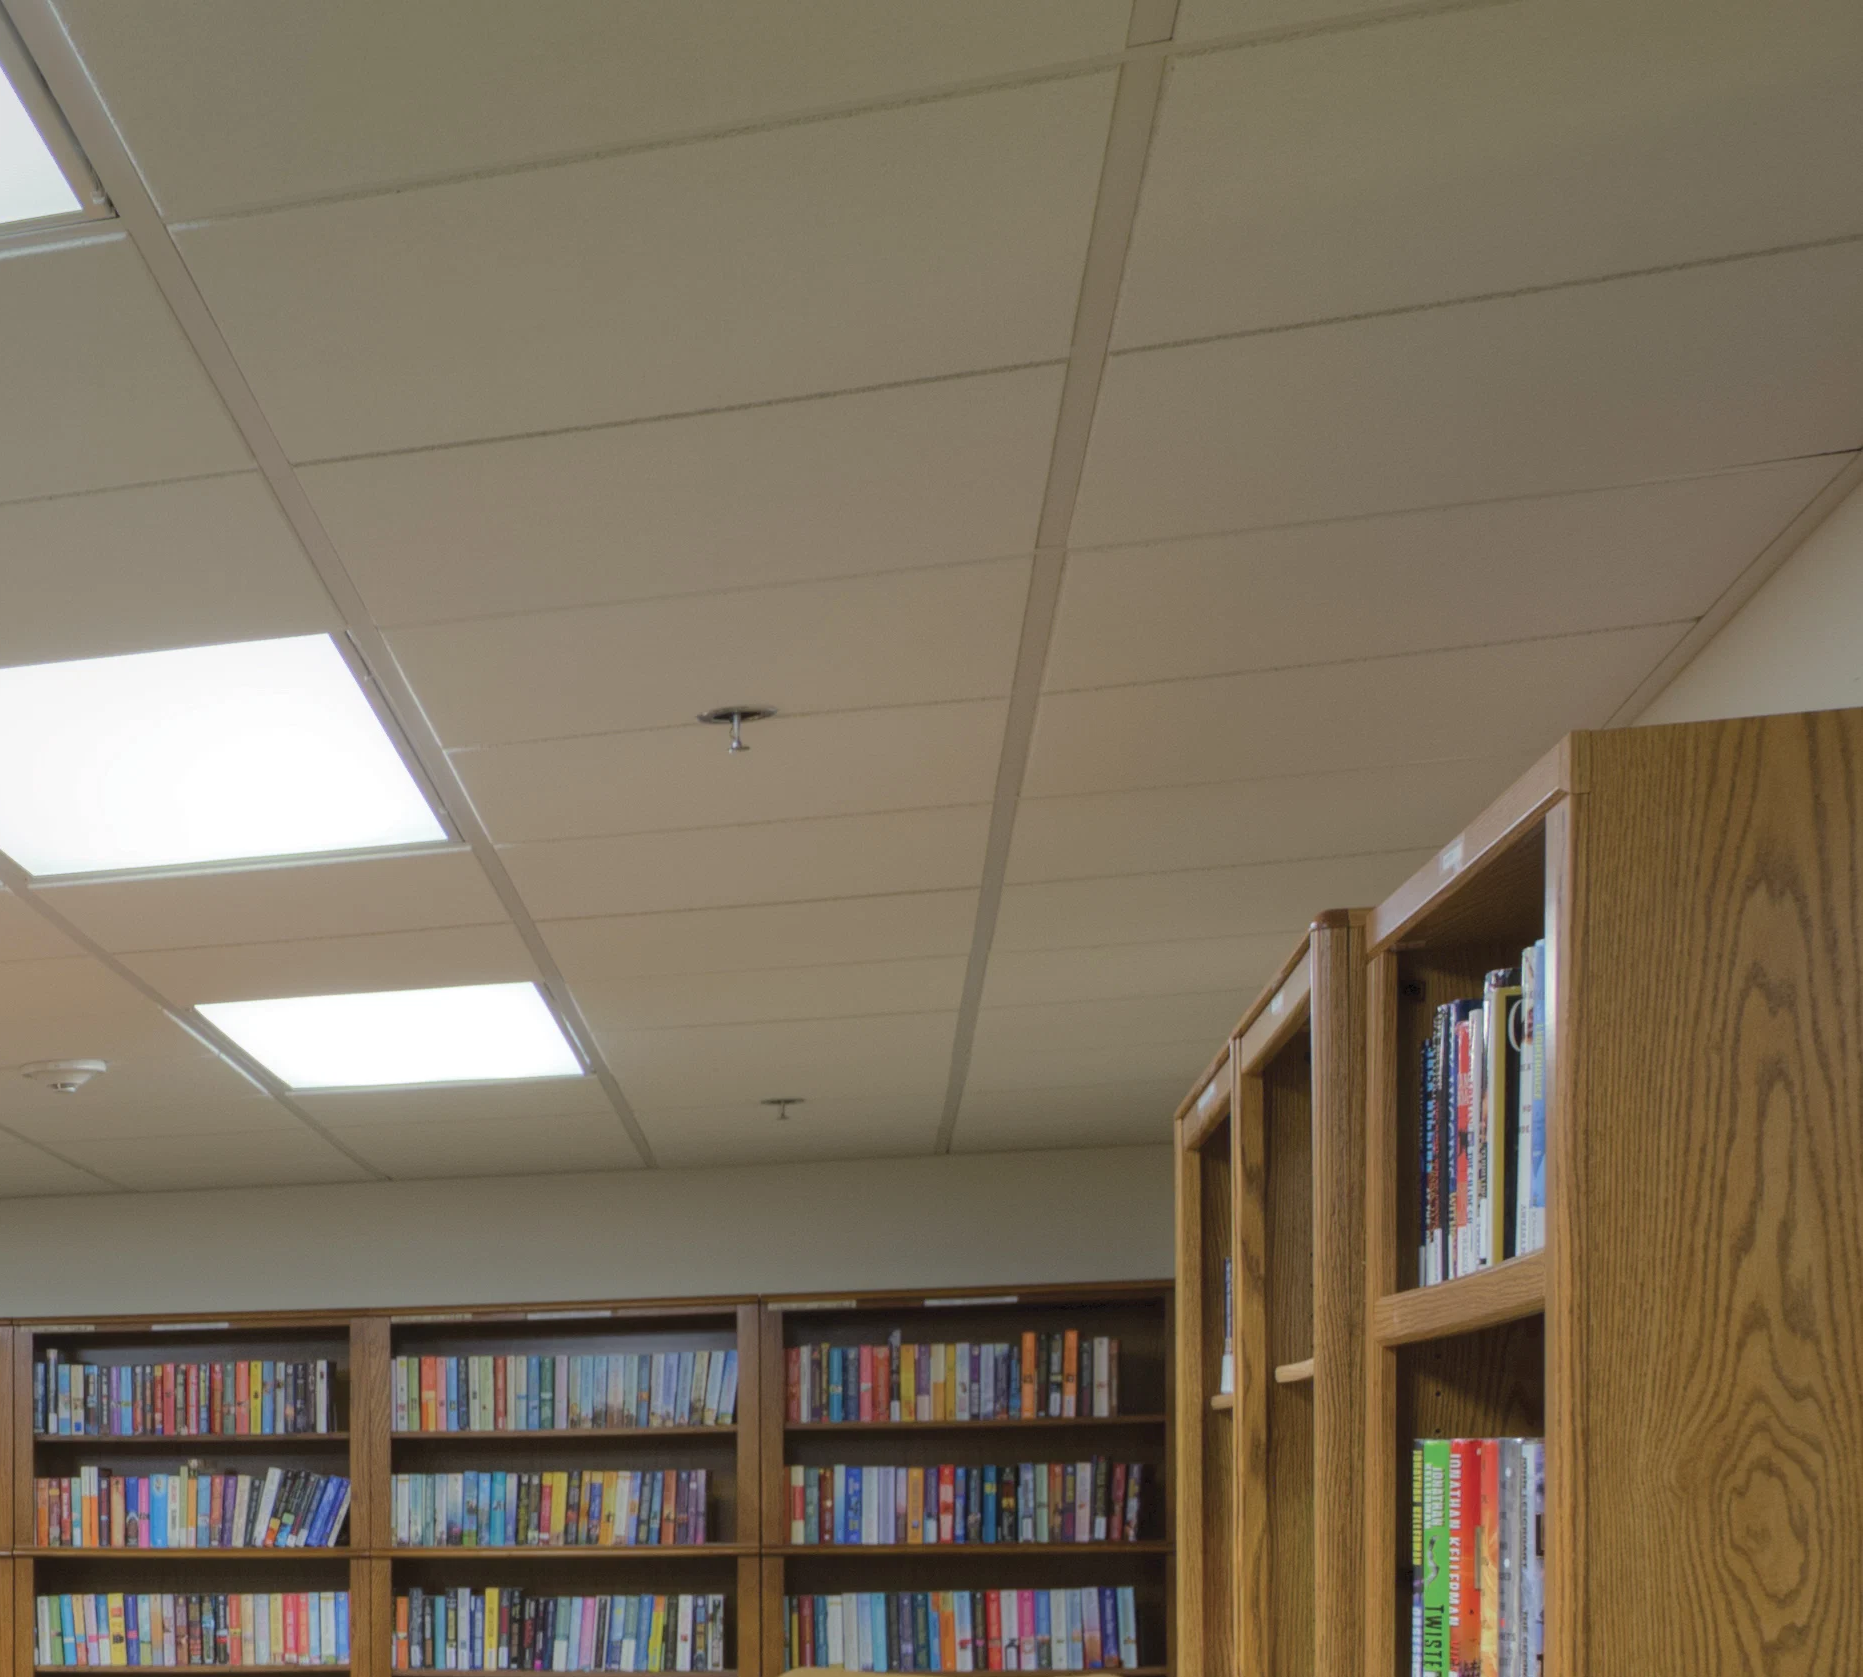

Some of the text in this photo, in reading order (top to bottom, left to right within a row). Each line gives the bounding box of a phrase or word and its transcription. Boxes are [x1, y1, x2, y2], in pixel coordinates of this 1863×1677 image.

[1534, 1024, 1543, 1099] LIGHTHOUSE
[1433, 1468, 1444, 1526] JONATHAN
[1449, 1453, 1461, 1627] JONATHAN KELLERMAN
